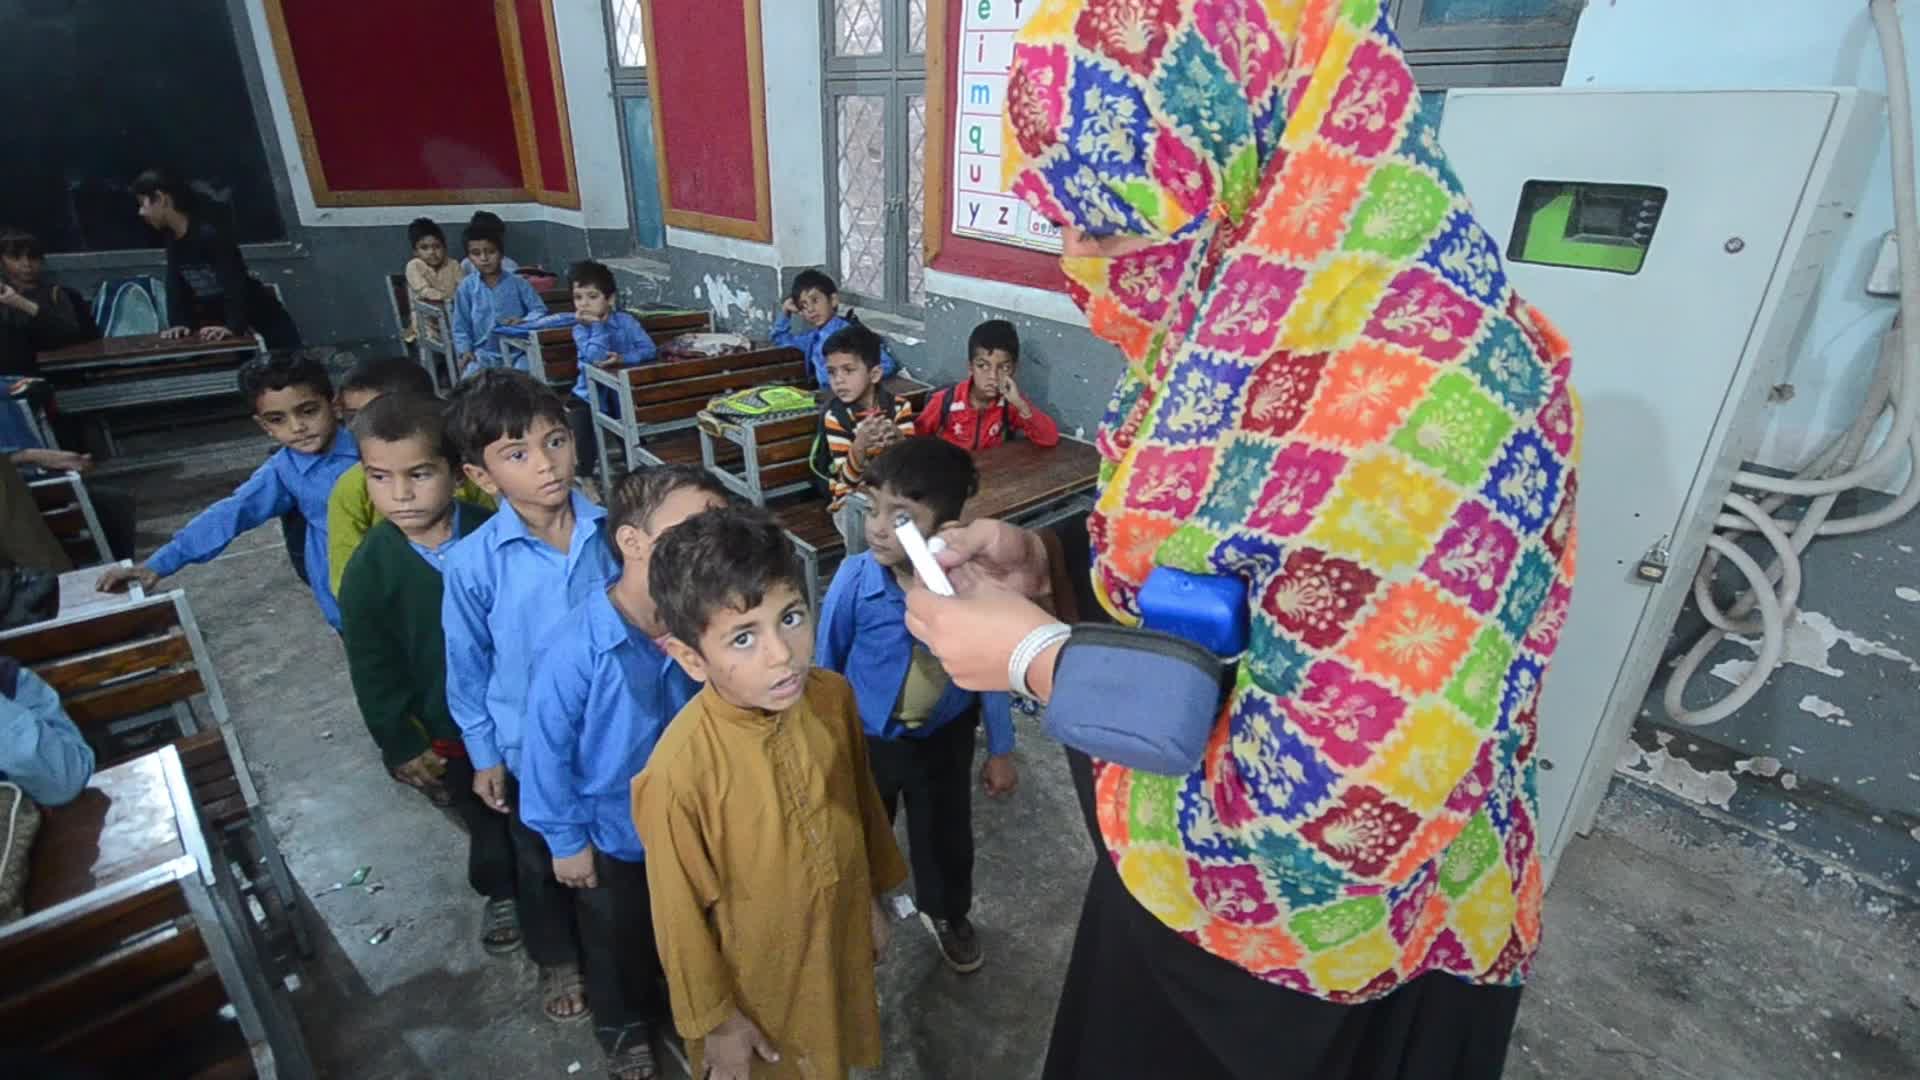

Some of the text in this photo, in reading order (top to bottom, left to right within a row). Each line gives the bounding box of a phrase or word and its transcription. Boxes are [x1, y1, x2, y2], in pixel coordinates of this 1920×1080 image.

[978, 0, 991, 20] e
[978, 34, 984, 63] i
[970, 84, 990, 104] m
[969, 125, 985, 154] q
[970, 163, 982, 183] u
[969, 201, 1009, 227] y z
